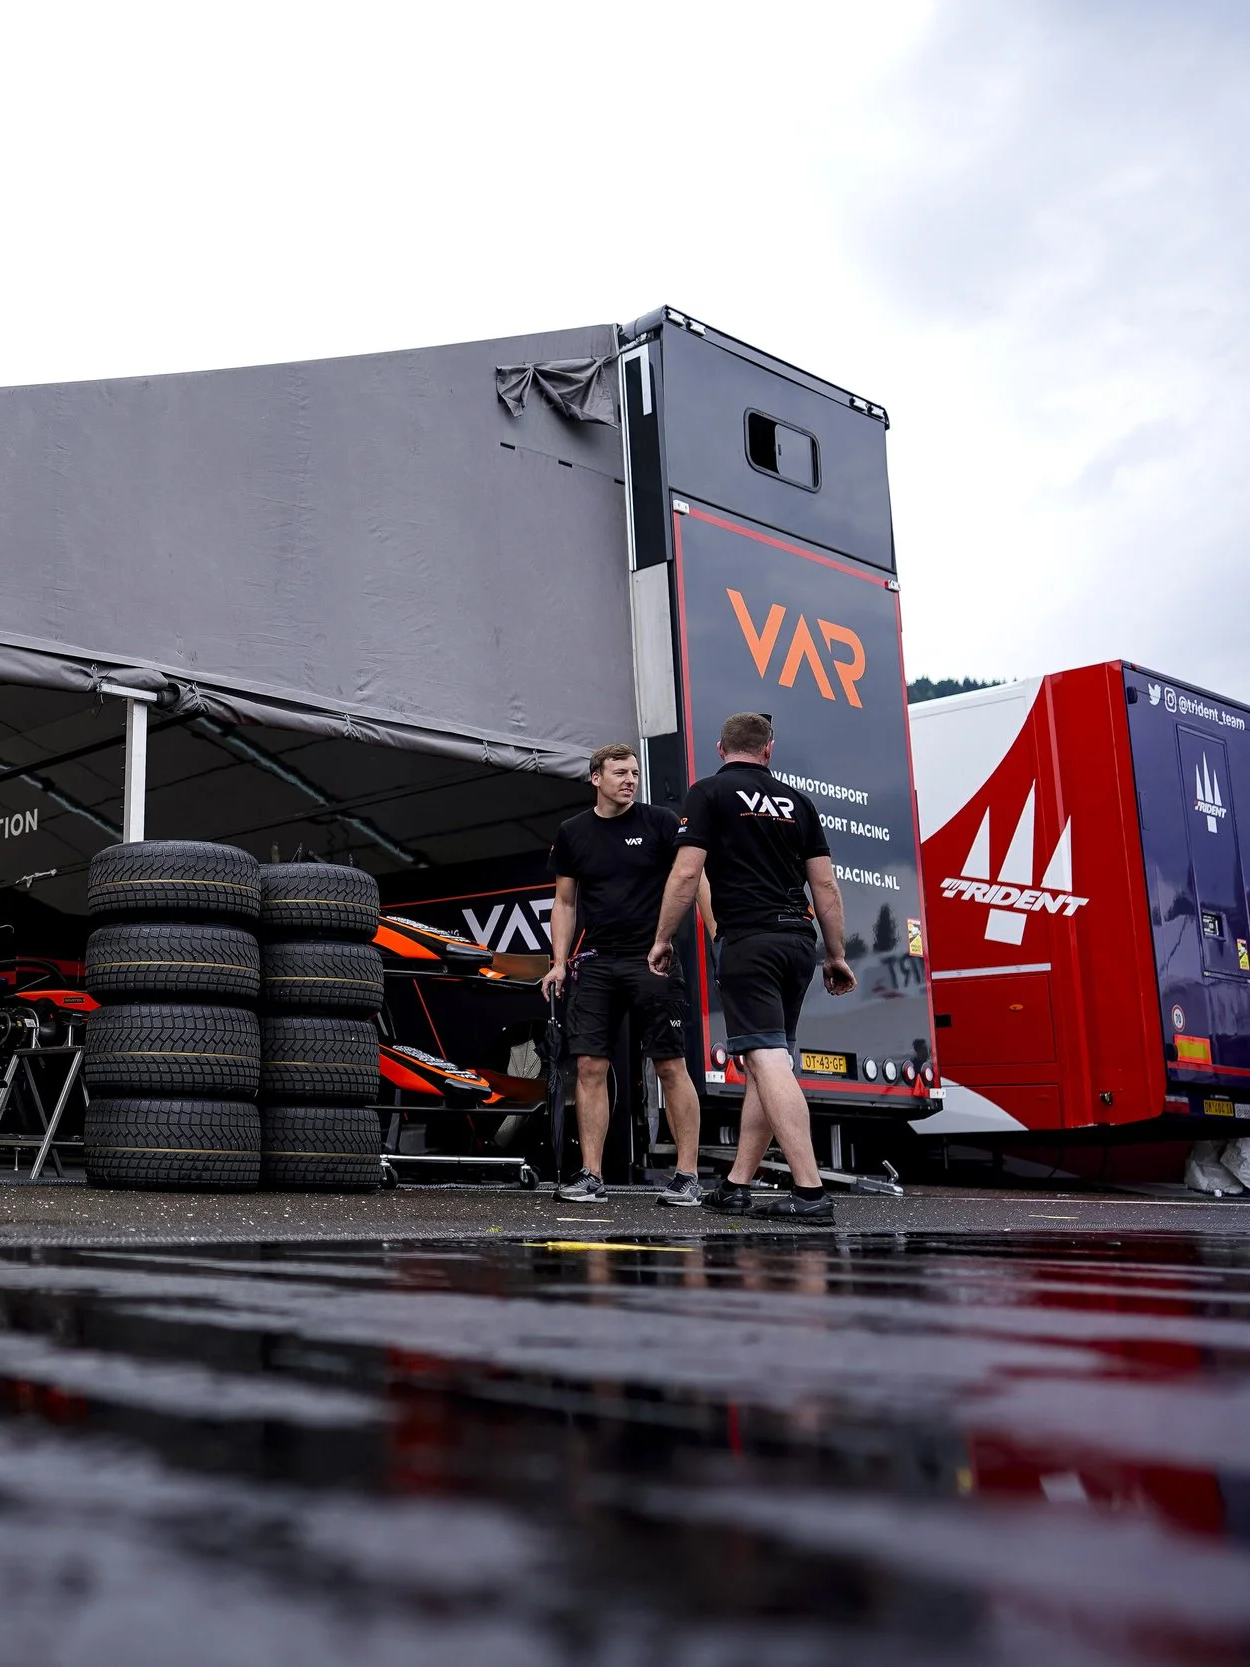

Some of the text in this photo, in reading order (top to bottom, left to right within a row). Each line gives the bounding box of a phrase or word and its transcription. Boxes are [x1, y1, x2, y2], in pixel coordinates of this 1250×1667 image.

[726, 587, 866, 709] VAR
[1178, 696, 1245, 731] @trident_team
[770, 770, 868, 806] VARMOTORSPORT
[736, 790, 795, 819] VAR
[1194, 800, 1227, 819] TRIDENT
[624, 837, 643, 846] VAR
[818, 813, 847, 832] OORT
[850, 821, 890, 842] RACING
[940, 877, 1090, 917] TRIDENT
[669, 1019, 682, 1028] VAR
[805, 1054, 845, 1071] OT-43-GF
